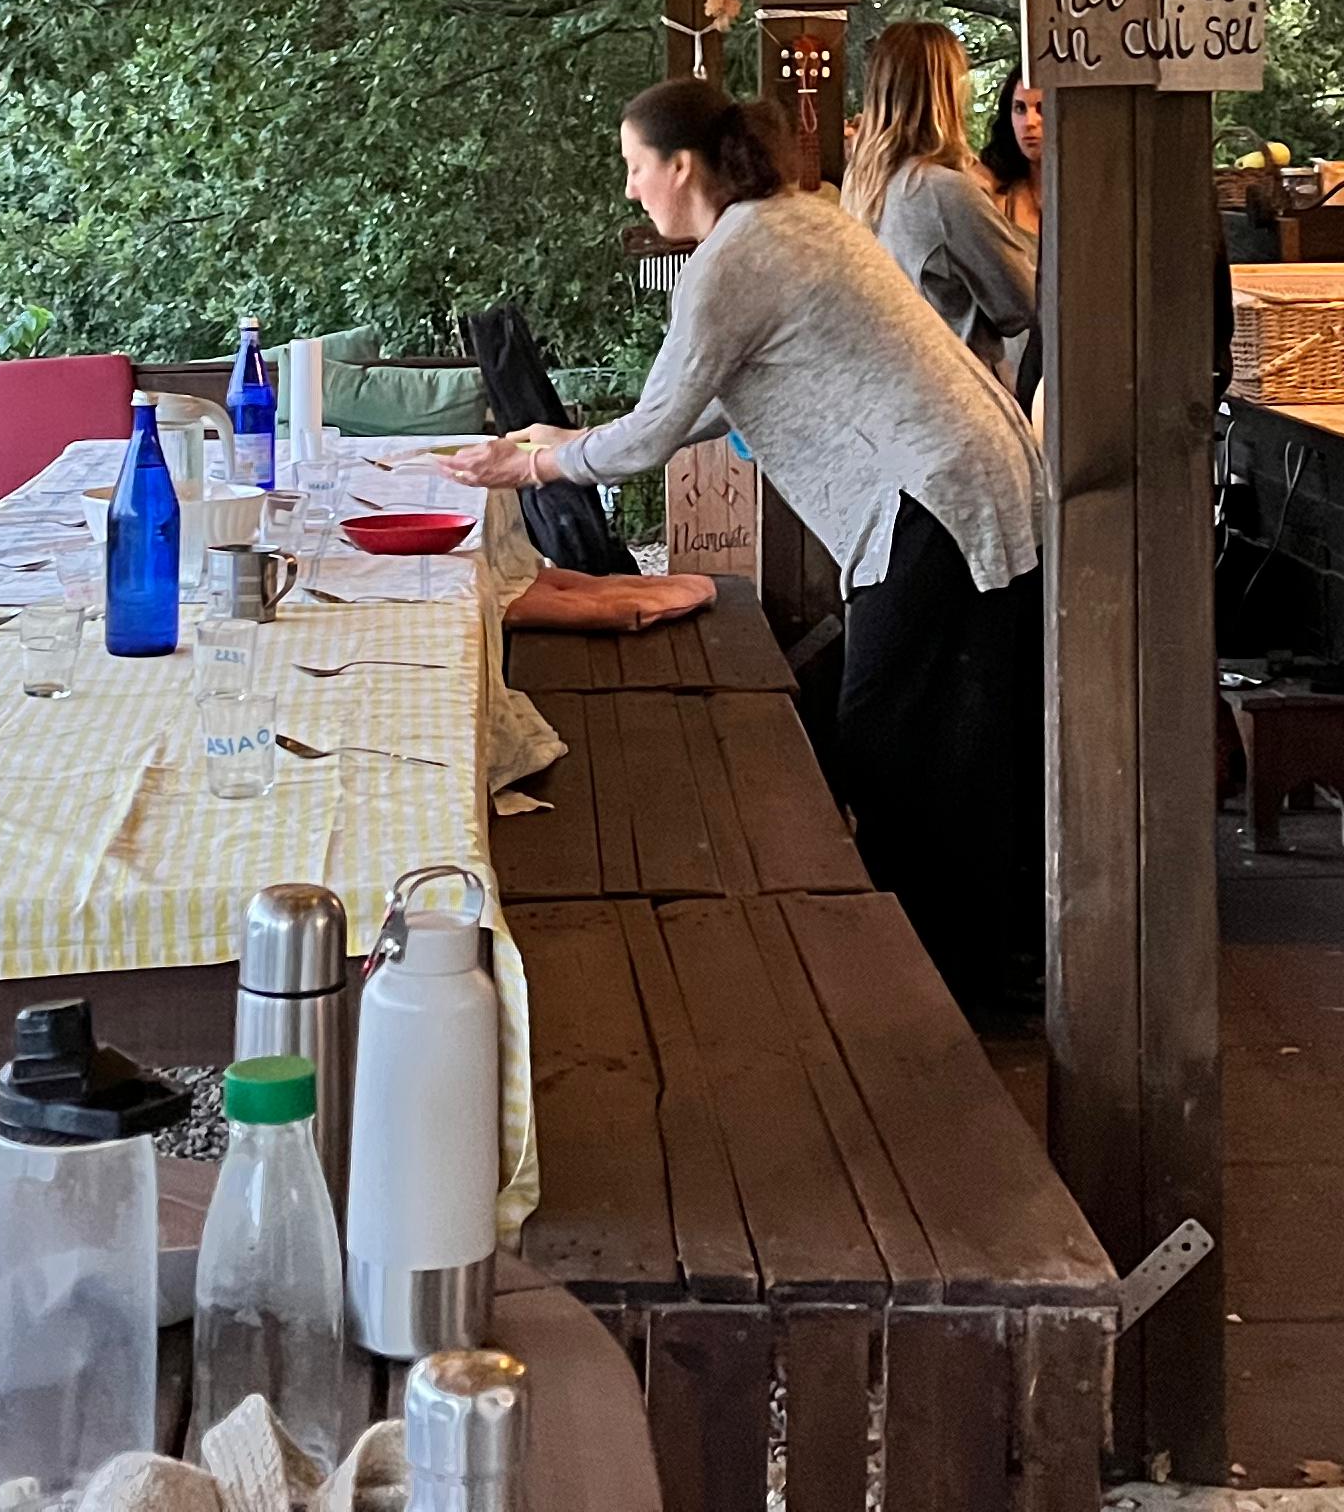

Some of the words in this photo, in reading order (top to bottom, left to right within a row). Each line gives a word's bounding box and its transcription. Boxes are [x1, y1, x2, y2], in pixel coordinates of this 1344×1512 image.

[1037, 16, 1101, 70] in
[1121, 4, 1196, 60] cui
[1203, 1, 1262, 60] sei
[674, 522, 752, 555] Namaste
